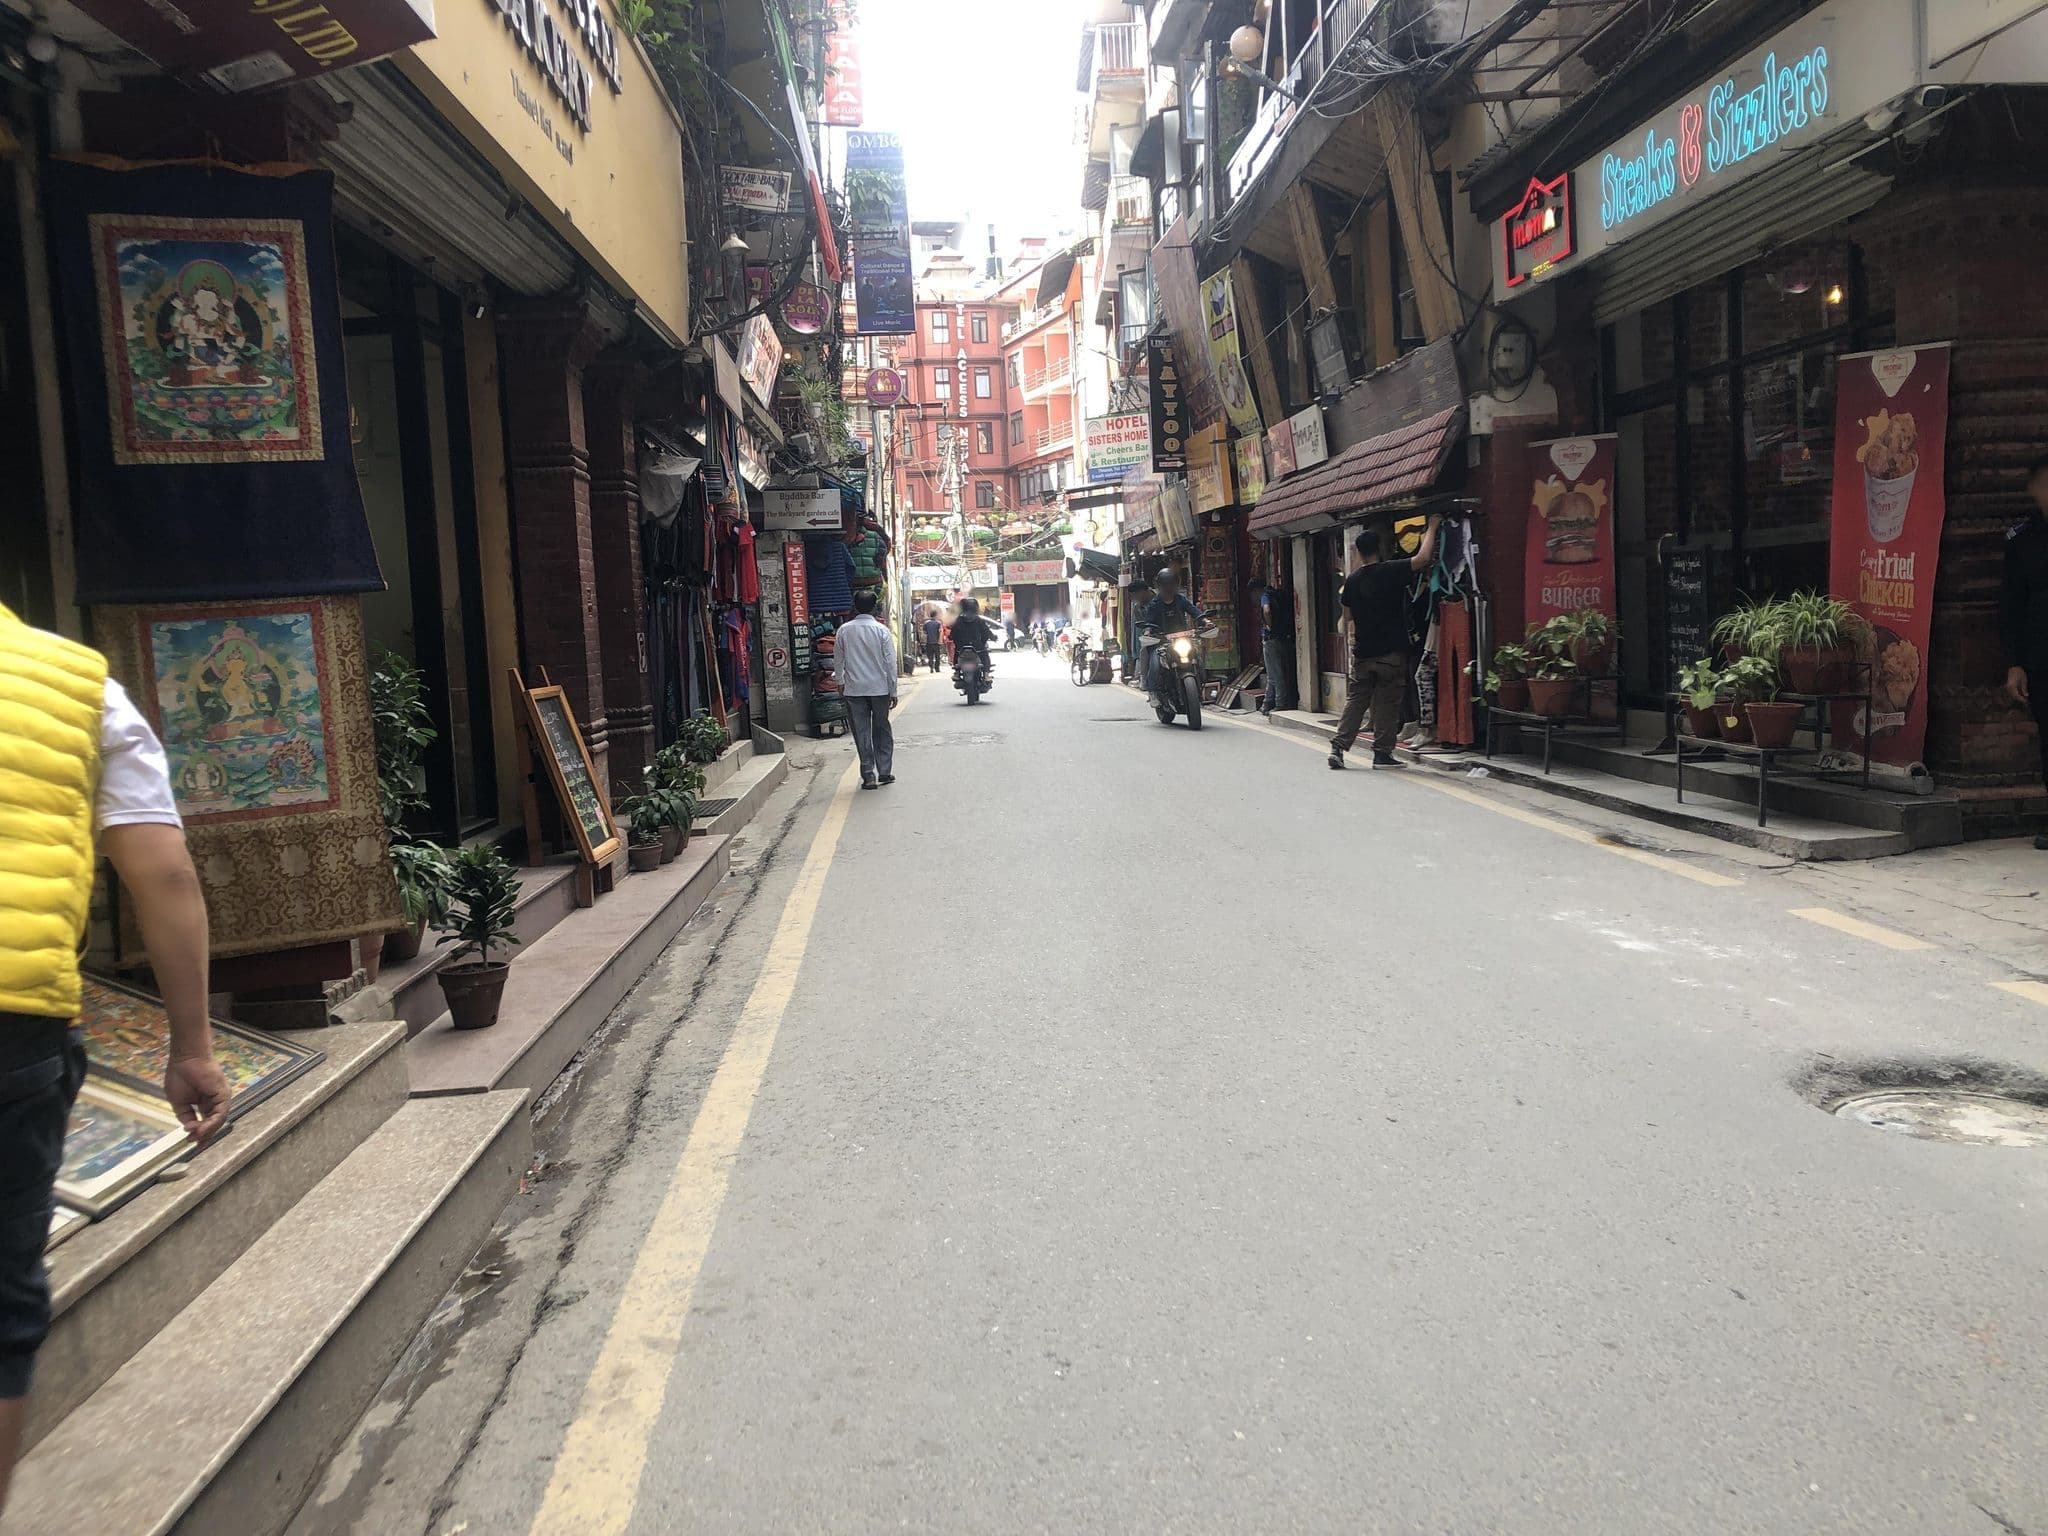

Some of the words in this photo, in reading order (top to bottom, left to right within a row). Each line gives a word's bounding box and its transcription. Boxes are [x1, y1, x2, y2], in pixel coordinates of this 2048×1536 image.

[272, 4, 358, 66] LTD.
[495, 0, 593, 134] AKERY
[1602, 129, 1675, 230] Steaks
[1680, 104, 1702, 186] &
[1708, 46, 1828, 173] Sizzlers
[957, 348, 968, 418] ACCESS
[1159, 348, 1180, 452] TATTOO
[1088, 432, 1122, 446] SISTERS
[1124, 430, 1148, 442] HOME
[1106, 415, 1147, 431] HOTEL
[959, 427, 969, 485] NEPAL
[1106, 446, 1133, 455] Cheers
[1135, 443, 1149, 452] Bar
[779, 491, 810, 500] Buddha
[811, 491, 825, 499] Bar
[807, 510, 826, 518] garden
[1877, 549, 1915, 581] Fried
[793, 586, 805, 624] POTALA
[1542, 586, 1601, 610] BURGER
[1860, 569, 1915, 609] Chicken
[793, 625, 808, 636] VEG
